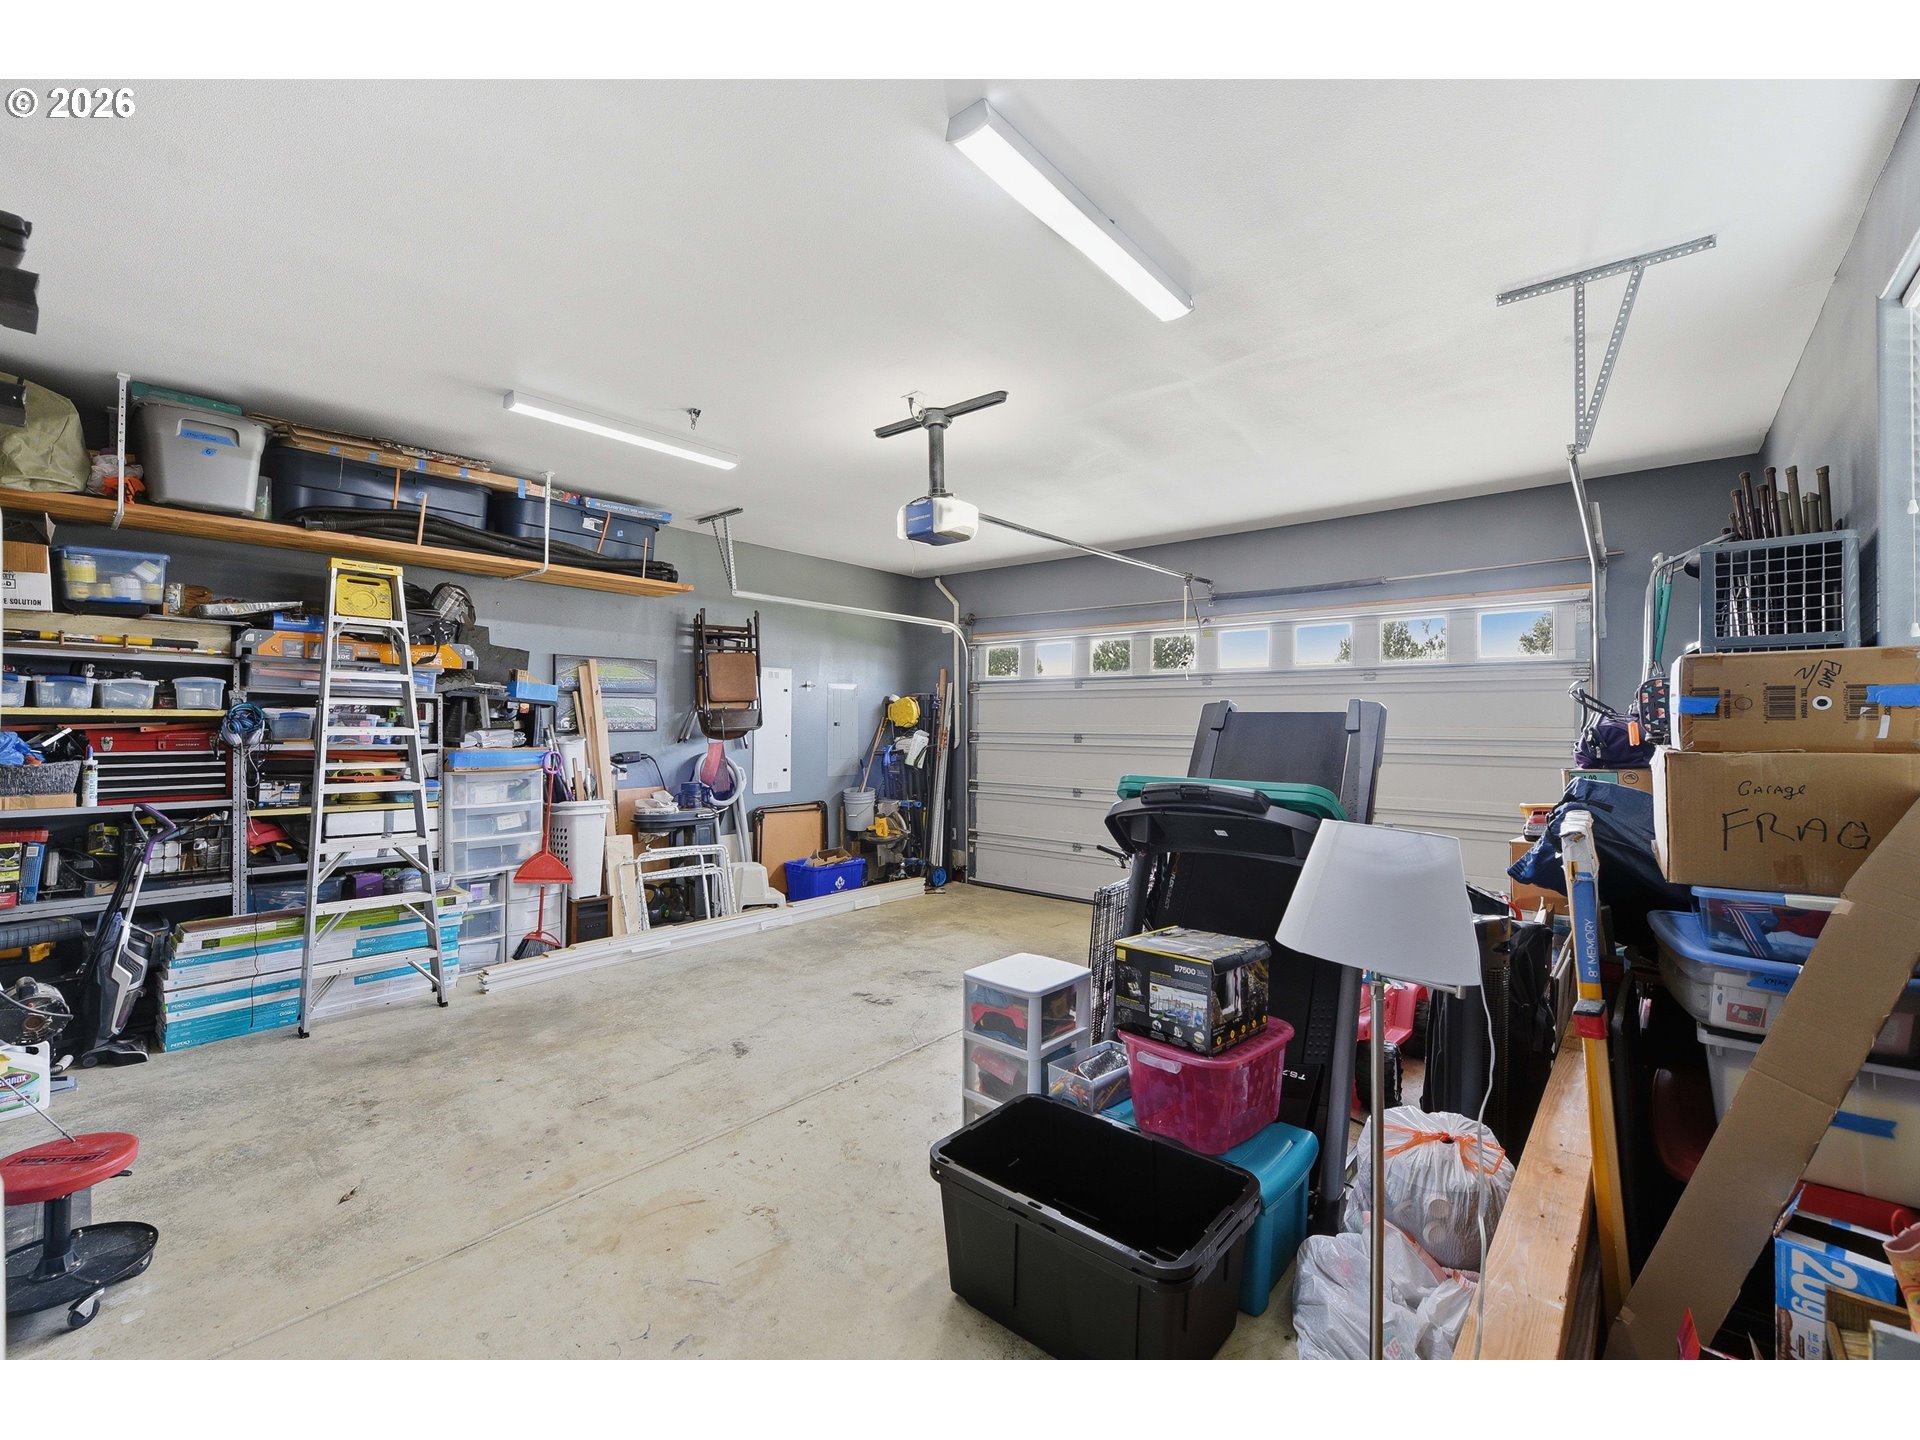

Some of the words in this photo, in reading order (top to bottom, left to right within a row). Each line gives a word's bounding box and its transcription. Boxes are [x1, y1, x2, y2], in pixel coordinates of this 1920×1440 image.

[10, 598, 42, 606] SOLUTION
[1722, 808, 1871, 851] FRAG
[1584, 918, 1598, 965] MEMORY
